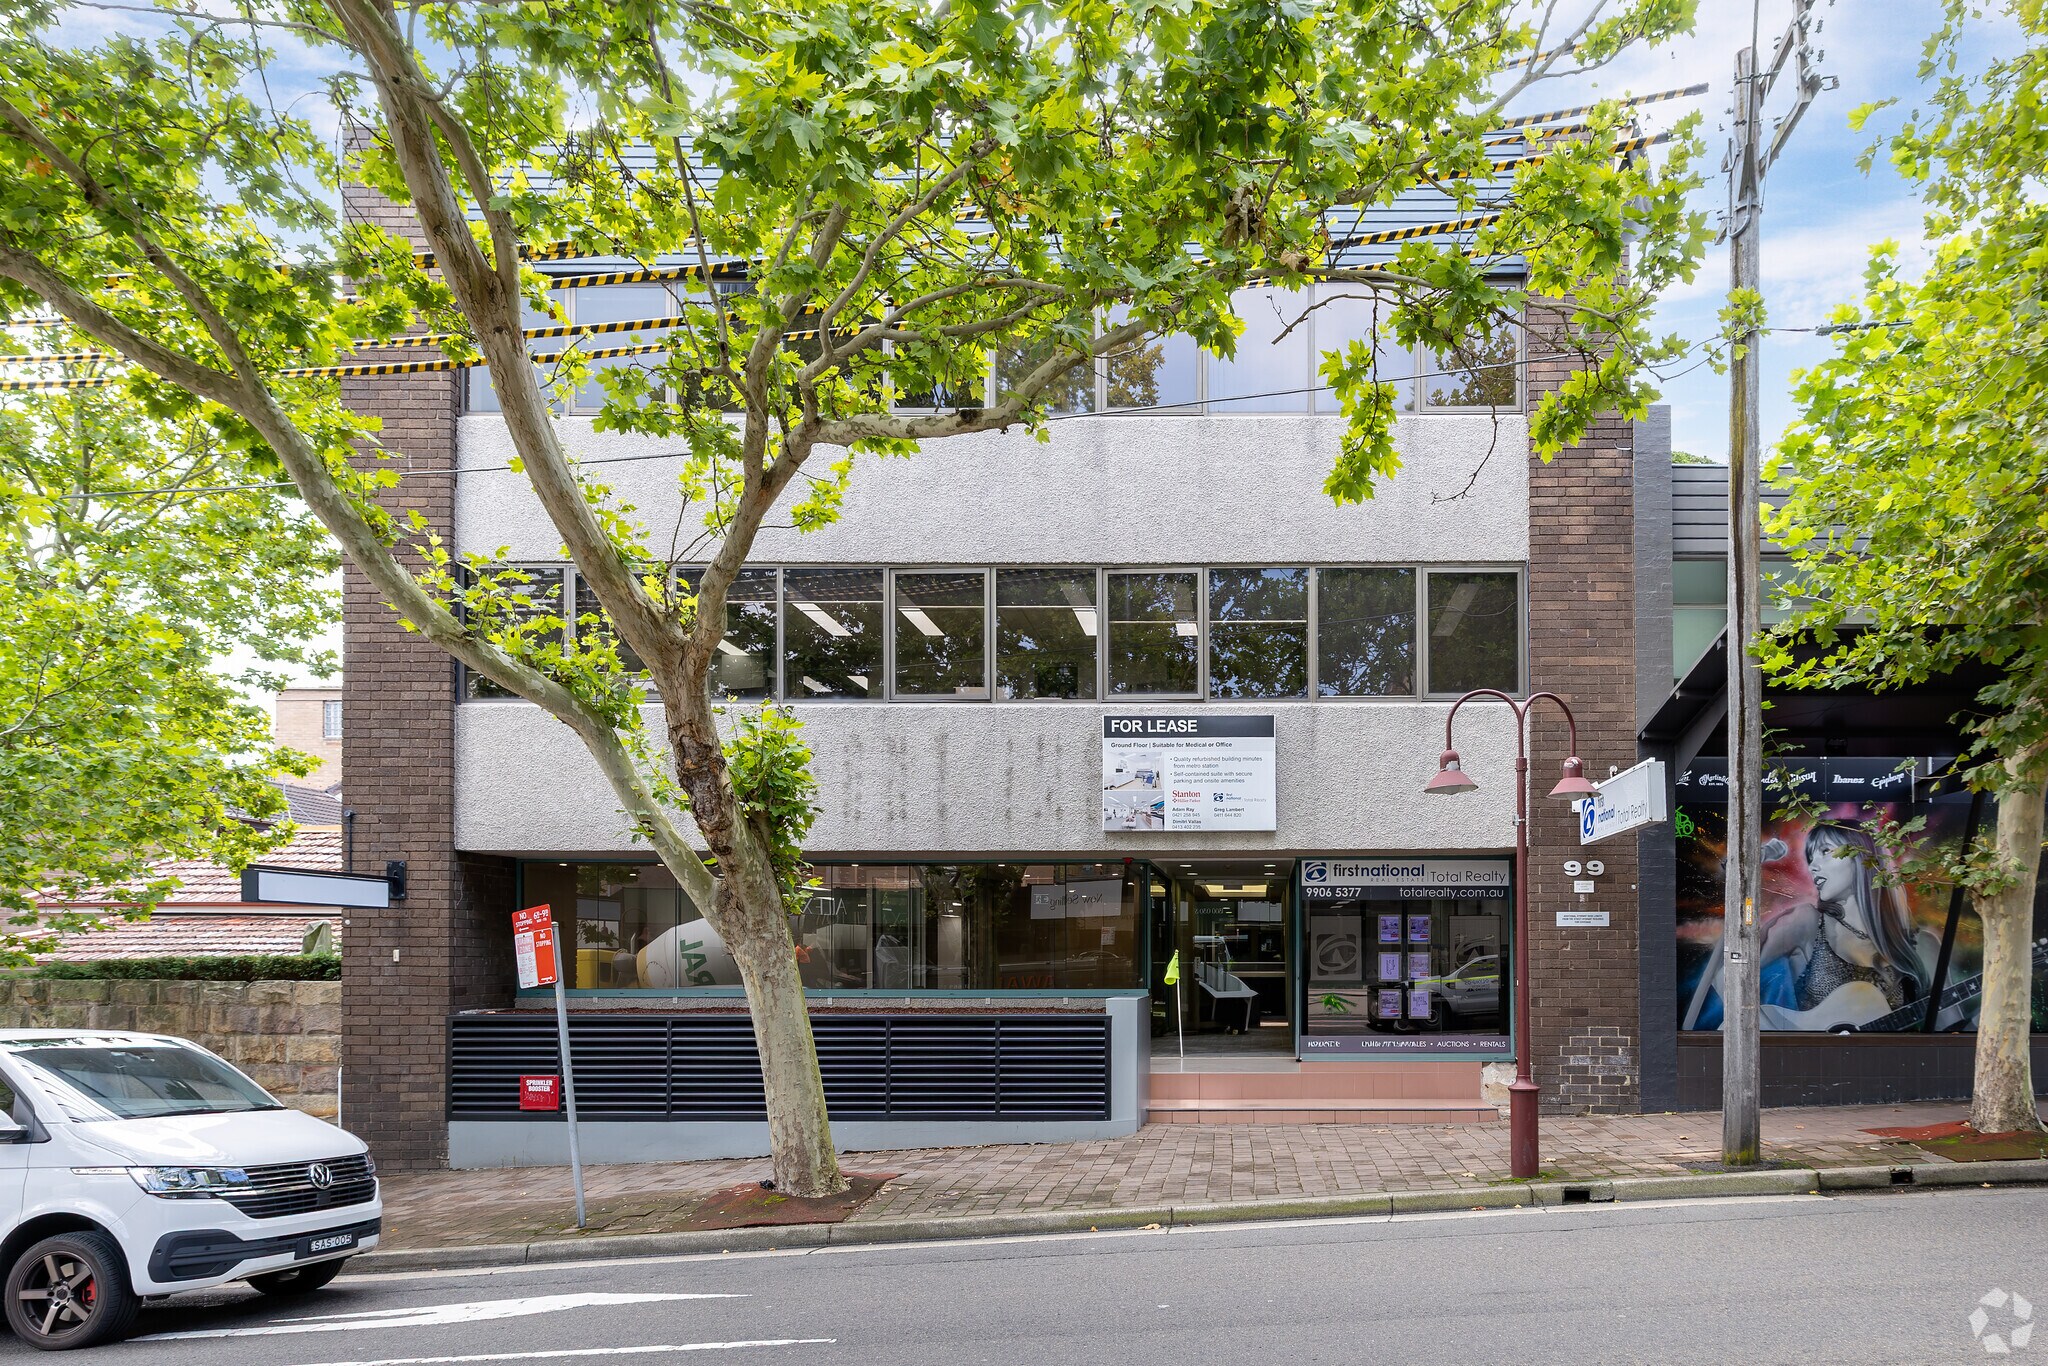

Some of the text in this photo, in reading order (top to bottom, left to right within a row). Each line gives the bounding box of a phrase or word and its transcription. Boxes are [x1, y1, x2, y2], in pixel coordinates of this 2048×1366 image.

[1111, 719, 1198, 733] FOR LEASE
[1832, 774, 1865, 784] Ibanez
[1870, 773, 1905, 789] Epiphone
[1172, 790, 1201, 798] Stanton
[1598, 803, 1615, 824] national
[1617, 799, 1648, 824] Total Realty
[1563, 860, 1605, 877] 99
[1430, 871, 1462, 883] Total
[1465, 870, 1506, 884] Realty
[1306, 887, 1362, 898] 9906 5377
[1399, 887, 1504, 900] totalrealty.com.au
[519, 912, 527, 920] NO
[535, 939, 552, 948] STOPPING
